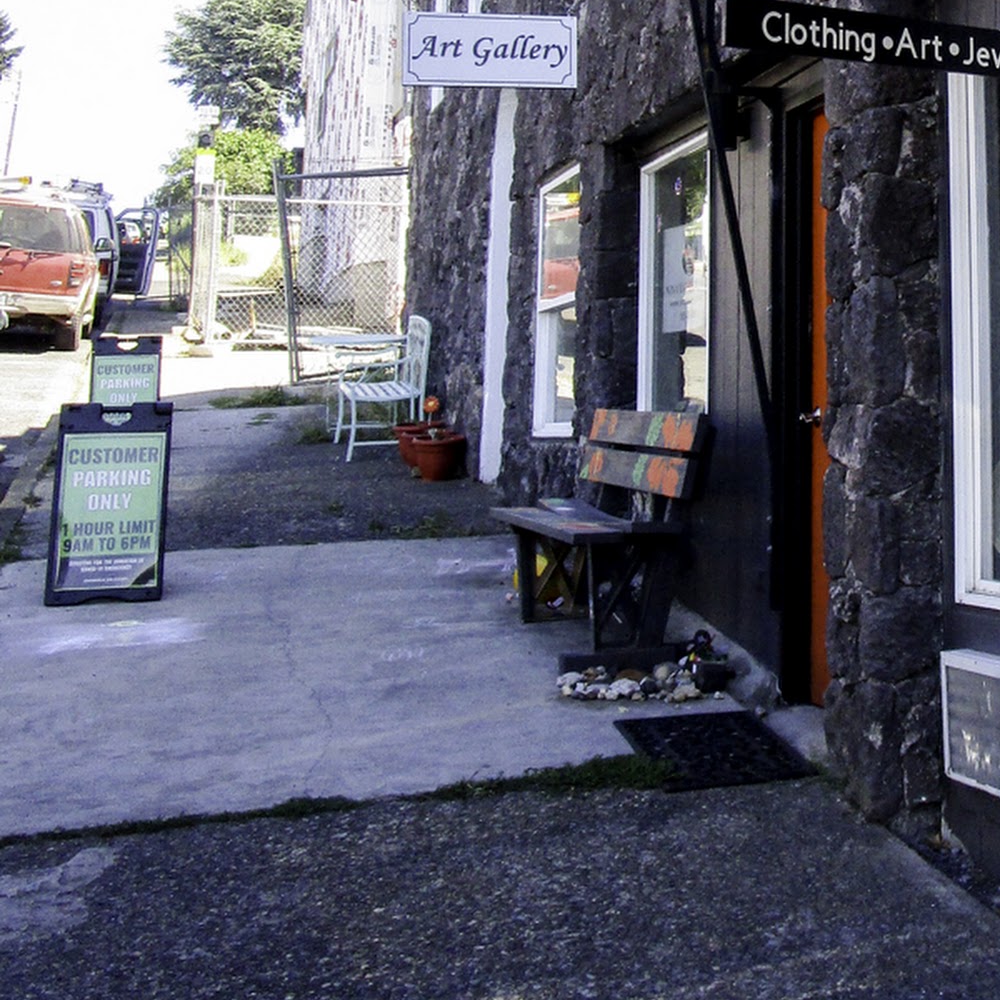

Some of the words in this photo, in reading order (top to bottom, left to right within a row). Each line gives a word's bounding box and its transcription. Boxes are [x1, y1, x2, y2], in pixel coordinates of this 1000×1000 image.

[761, 11, 876, 62] Clothing
[895, 27, 943, 62] Art
[411, 34, 463, 61] Art
[473, 34, 568, 68] Gallery
[97, 363, 155, 376] CUSTOMER
[100, 377, 150, 389] PARKING
[109, 392, 138, 404] ONLY
[68, 447, 159, 465] CUSTOMER
[72, 469, 151, 488] PARKING
[87, 493, 132, 511] ONLY
[62, 523, 69, 537] 1
[73, 521, 114, 536] HOUR
[119, 519, 157, 534] LIMIT
[62, 537, 97, 553] 9AM
[99, 535, 116, 550] TO
[121, 535, 151, 550] 6PM
